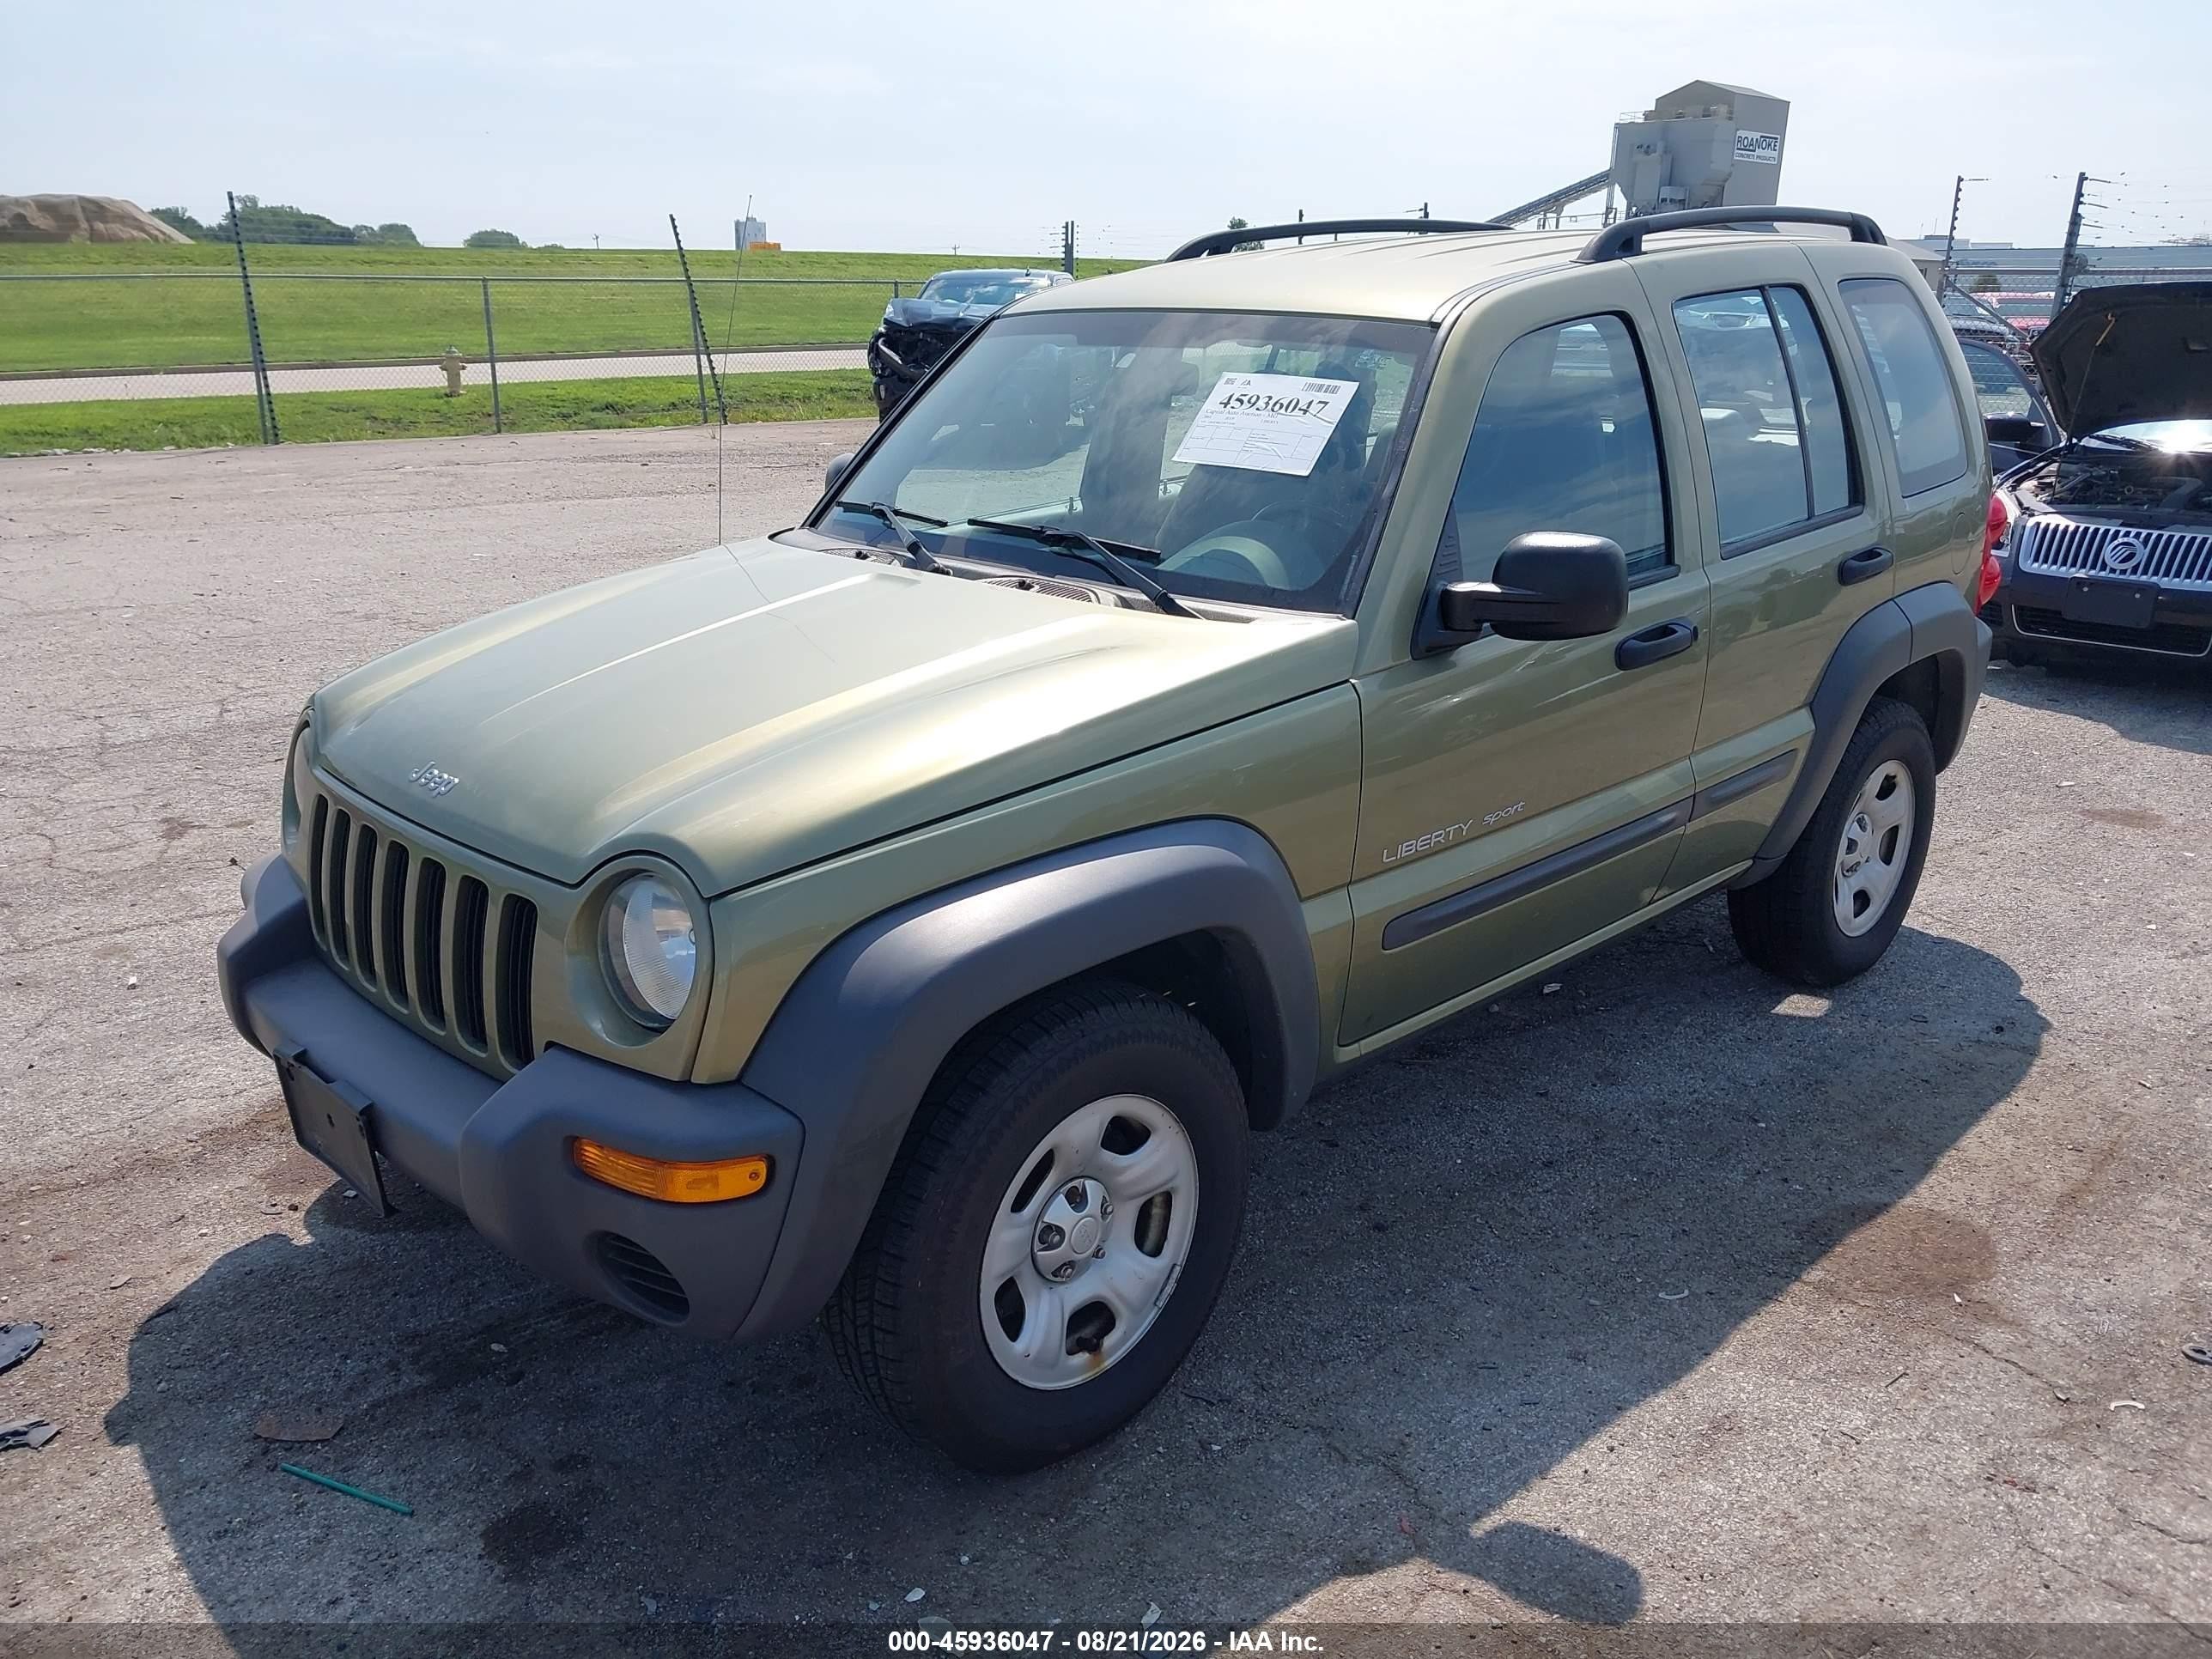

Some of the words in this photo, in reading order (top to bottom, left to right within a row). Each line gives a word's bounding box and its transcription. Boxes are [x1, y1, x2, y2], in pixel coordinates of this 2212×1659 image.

[1736, 135, 1778, 152] ROANOKE
[1218, 392, 1330, 417] 45936047
[409, 761, 459, 799] Jeep
[1382, 819, 1474, 863] LIBERTY
[1482, 801, 1525, 825] sport
